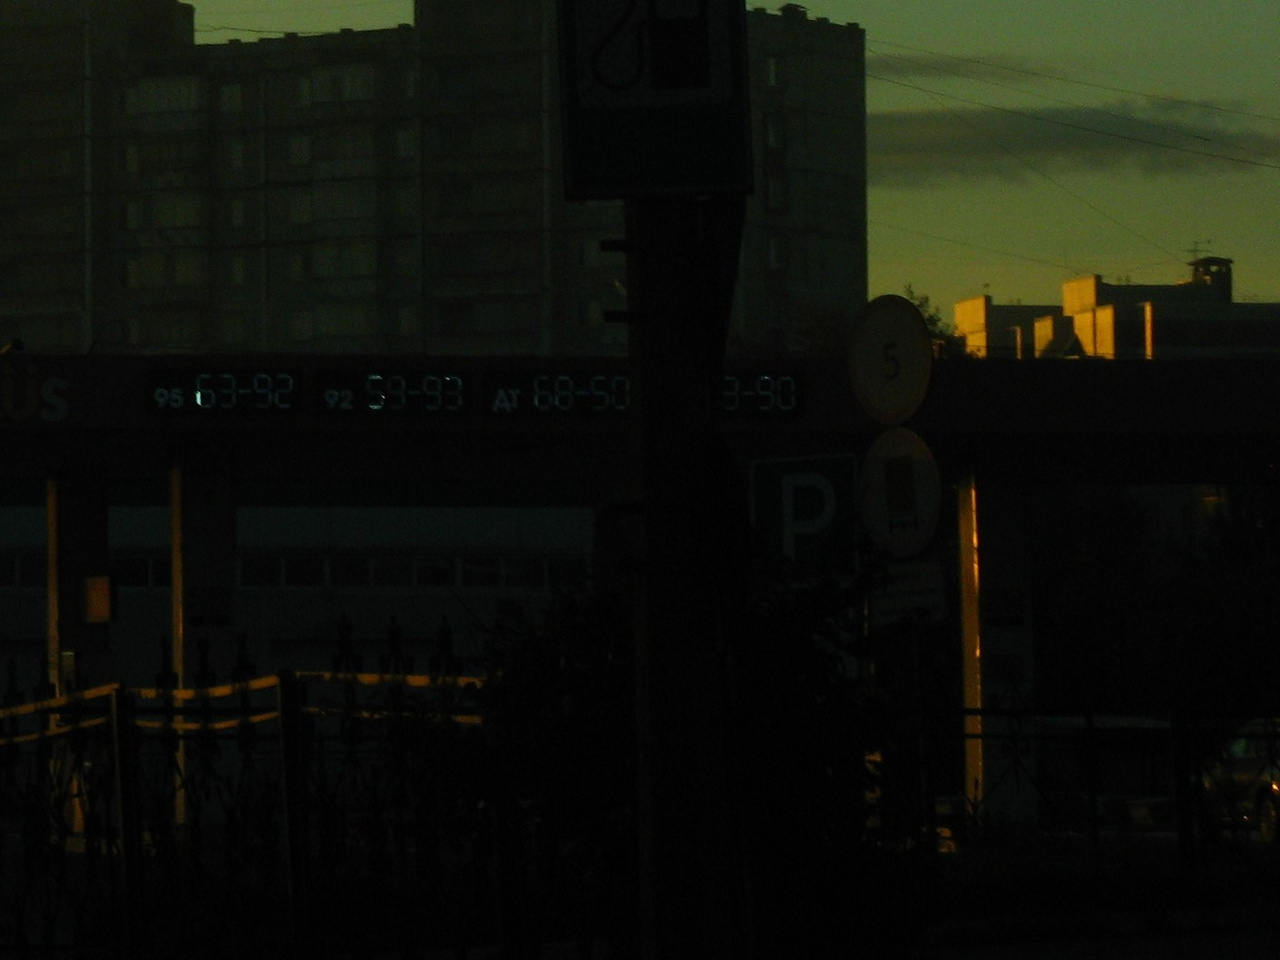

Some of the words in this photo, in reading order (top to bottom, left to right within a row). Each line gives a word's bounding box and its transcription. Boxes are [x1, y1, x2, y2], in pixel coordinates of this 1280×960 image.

[882, 342, 899, 380] 5
[154, 388, 184, 408] 95
[195, 373, 293, 409] 63-92
[324, 389, 353, 410] 92
[366, 374, 463, 410] 59-93
[533, 375, 630, 411] 68-50
[782, 472, 837, 562] P
